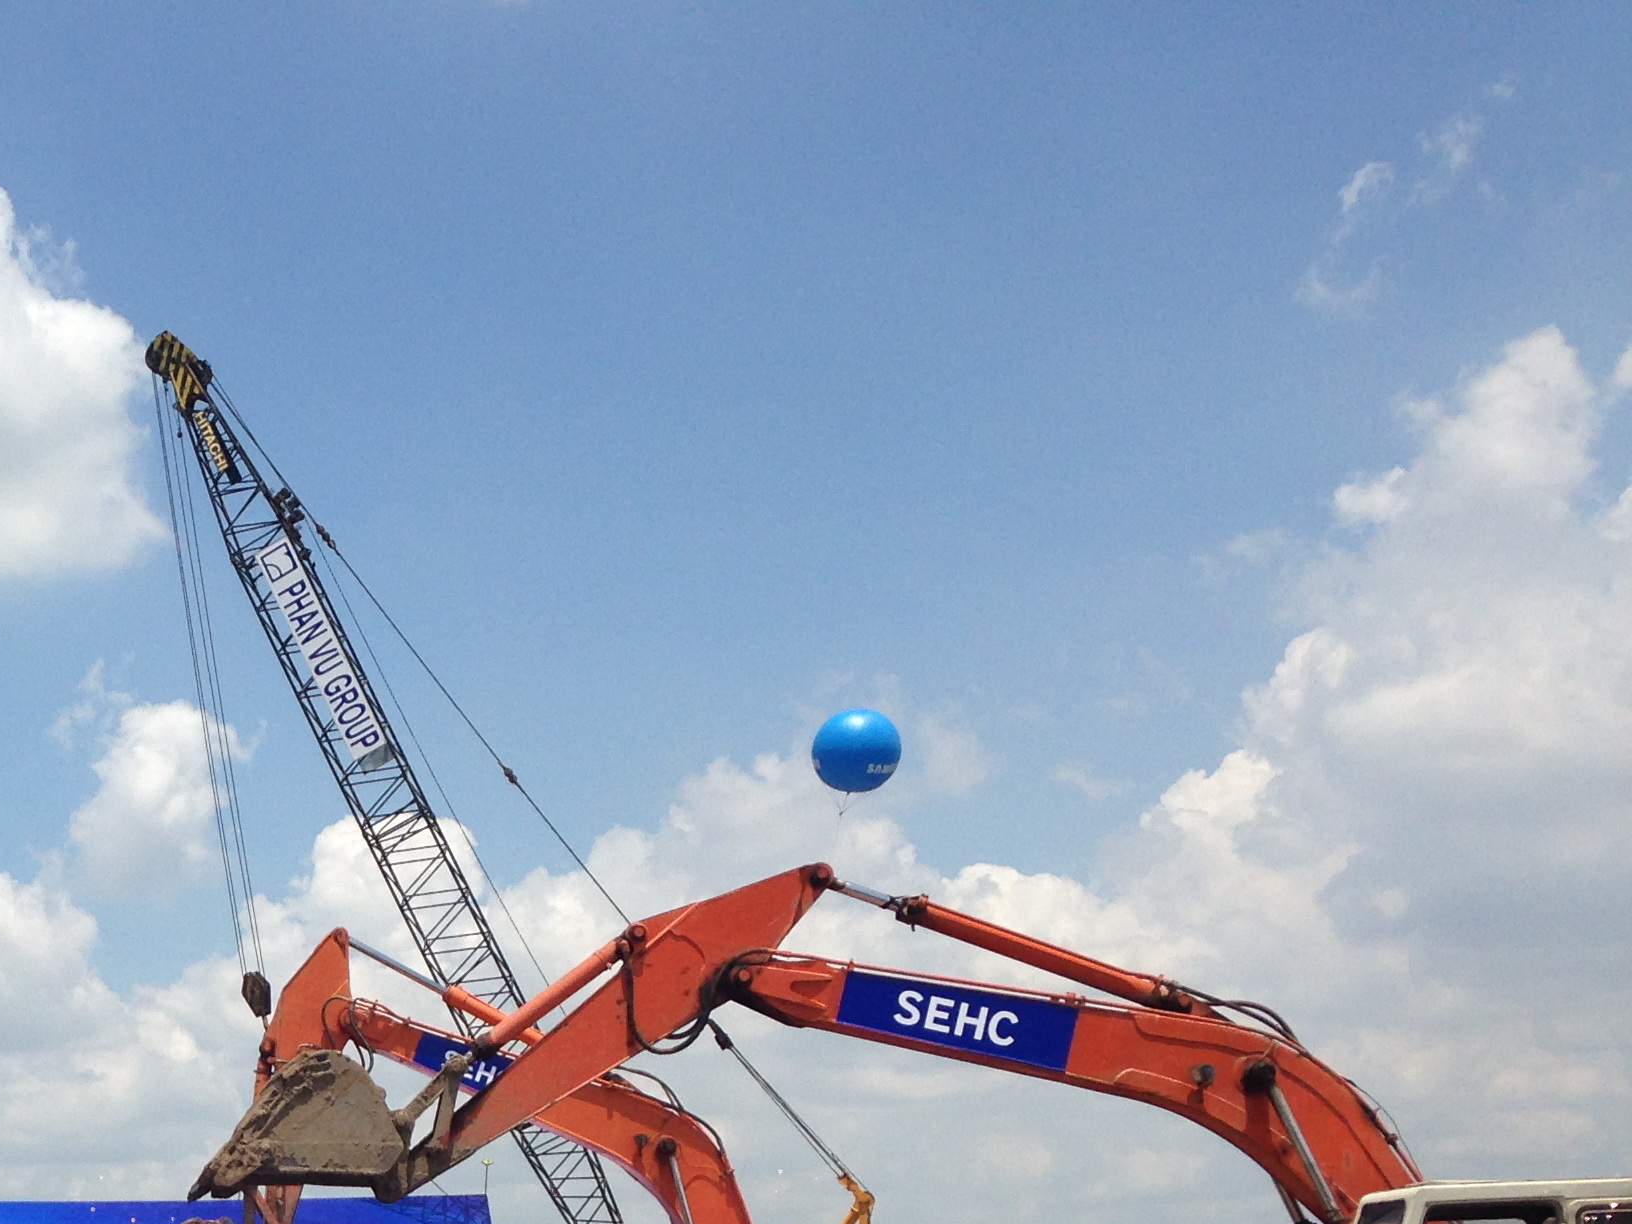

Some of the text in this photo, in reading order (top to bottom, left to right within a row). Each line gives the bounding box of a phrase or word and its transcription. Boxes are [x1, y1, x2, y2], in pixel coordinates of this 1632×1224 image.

[194, 411, 229, 472] HITACHI
[277, 578, 380, 748] PHAN VU GROUP
[893, 989, 1019, 1047] SEHC
